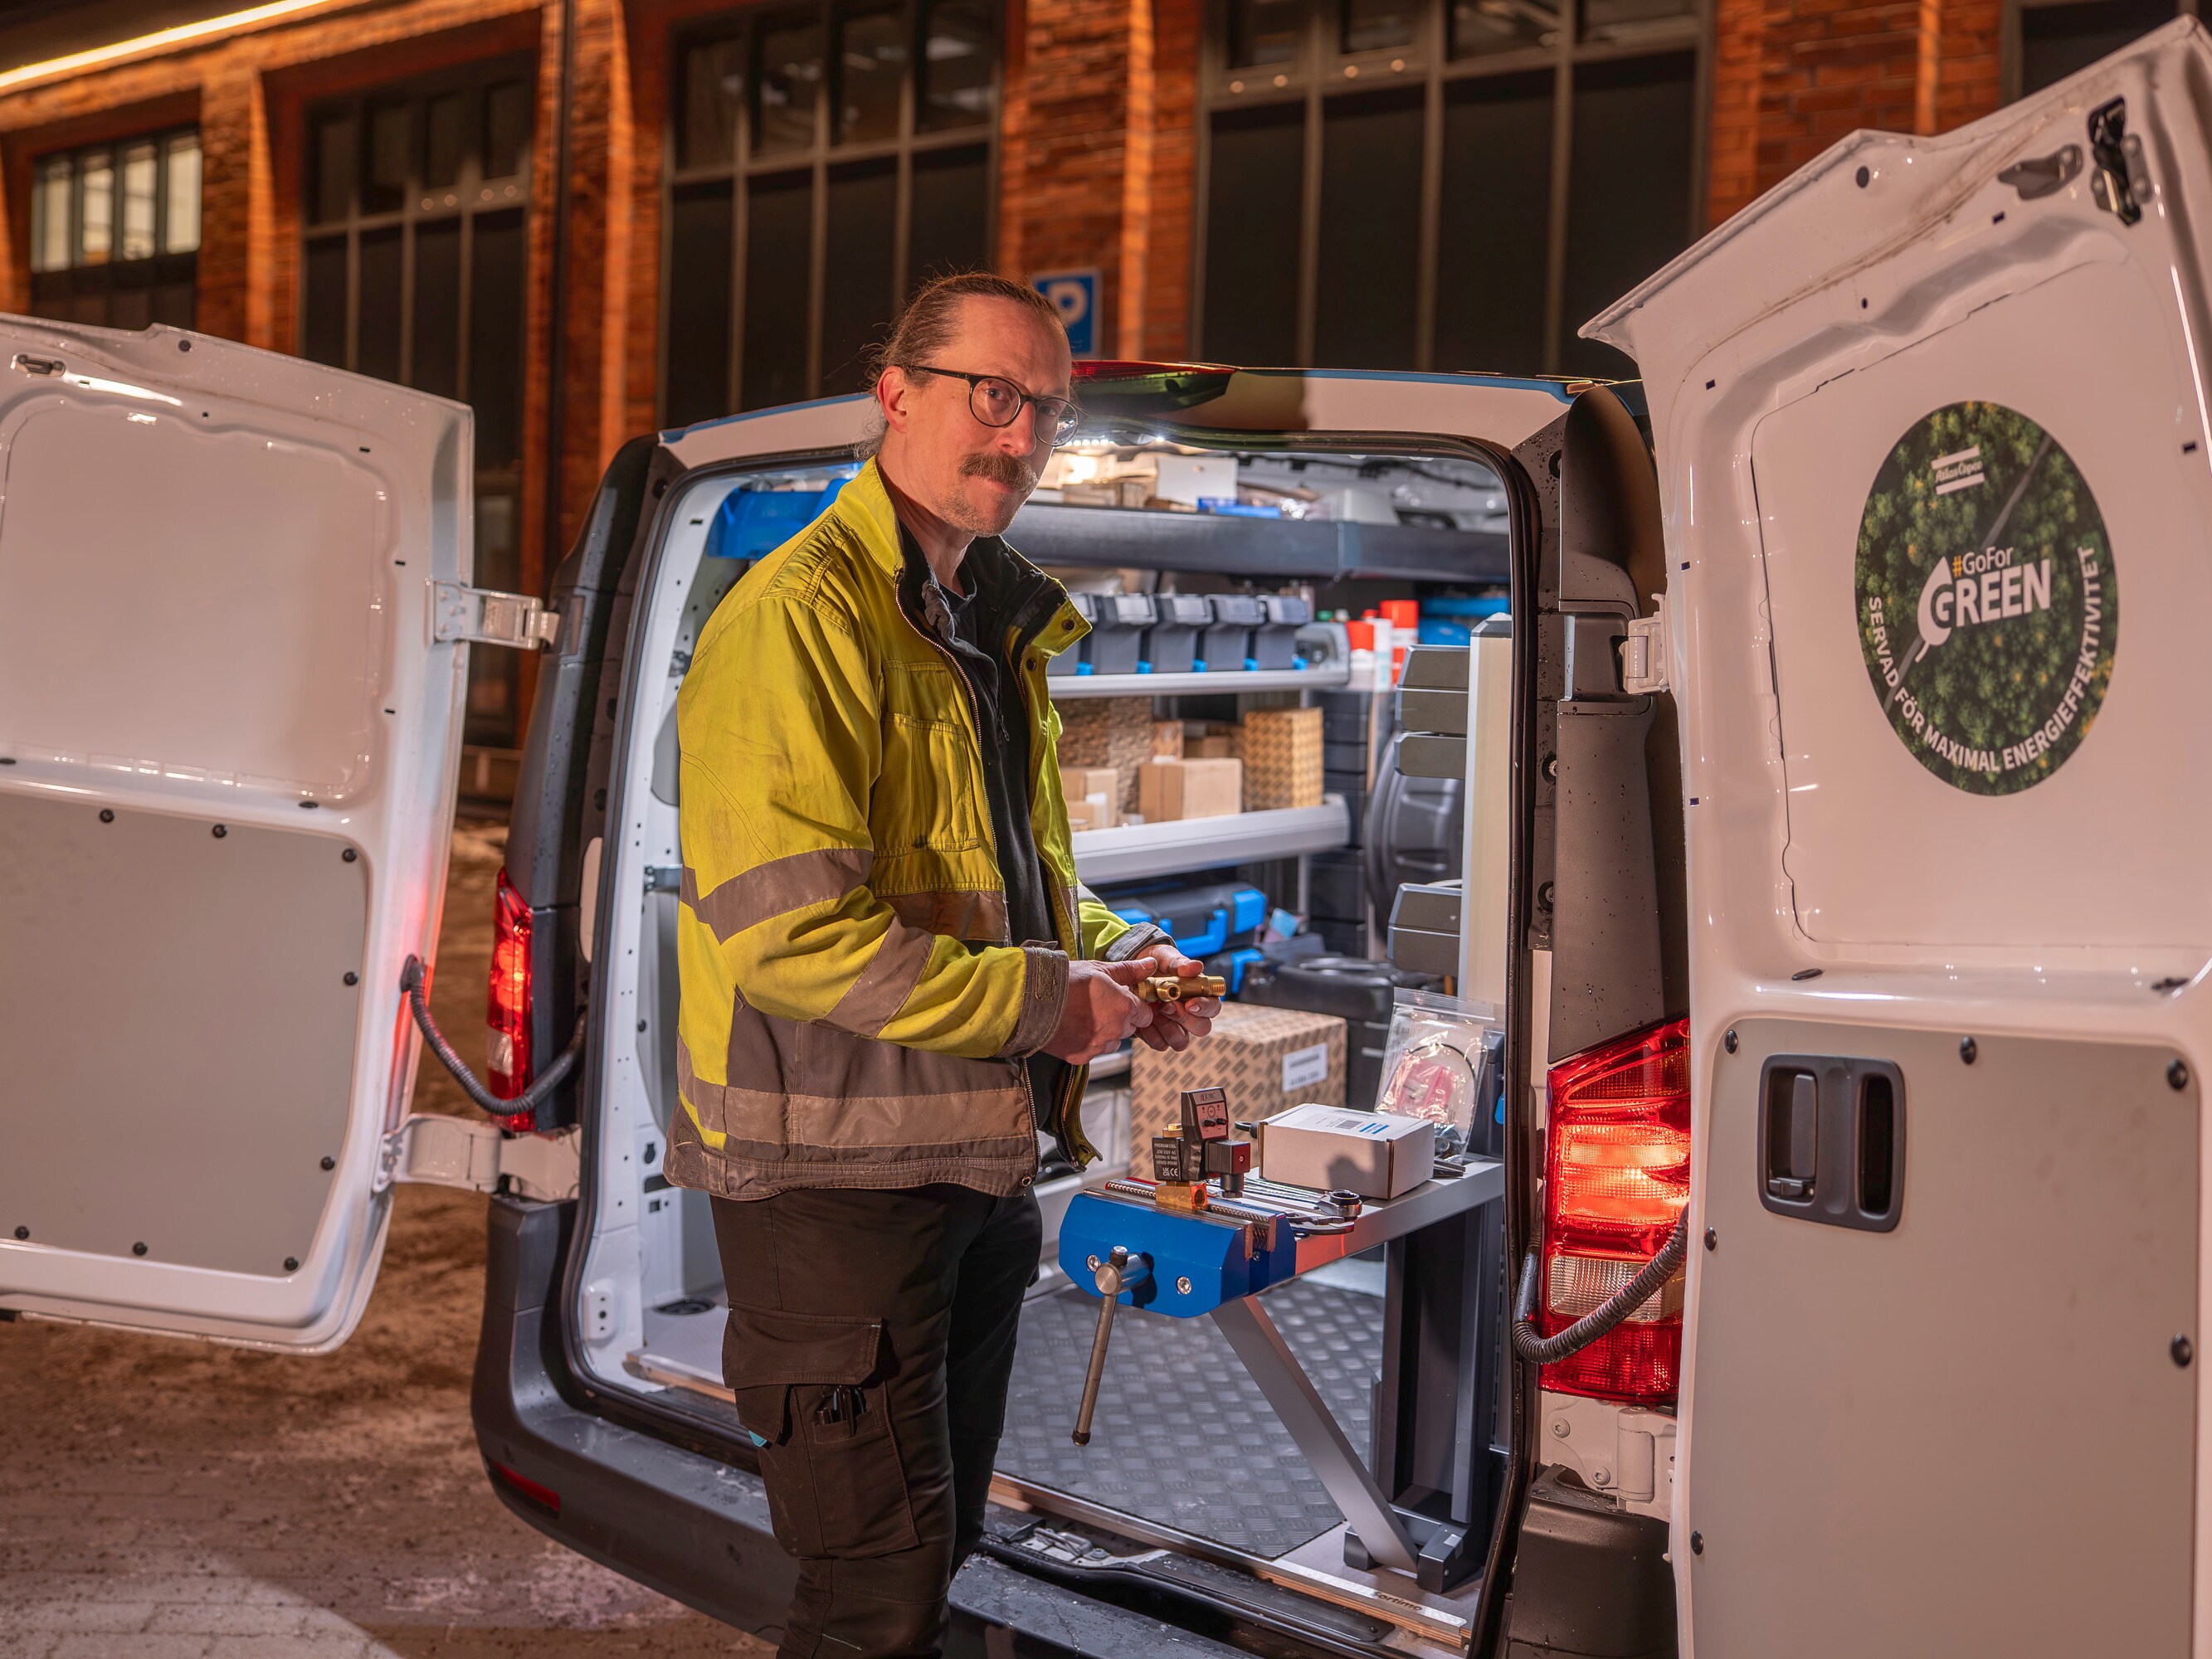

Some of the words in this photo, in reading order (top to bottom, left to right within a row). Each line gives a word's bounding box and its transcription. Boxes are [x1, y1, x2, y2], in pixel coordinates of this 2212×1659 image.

[1917, 557, 2051, 646] GREEN
[1952, 546, 2014, 577] #GoFor
[1869, 596, 1899, 687] SERVAD
[1894, 687, 1925, 734] FÖR
[1923, 724, 2000, 772] MAXIMAL
[2002, 546, 2102, 771] ENERGIEFFEKTIVITET
